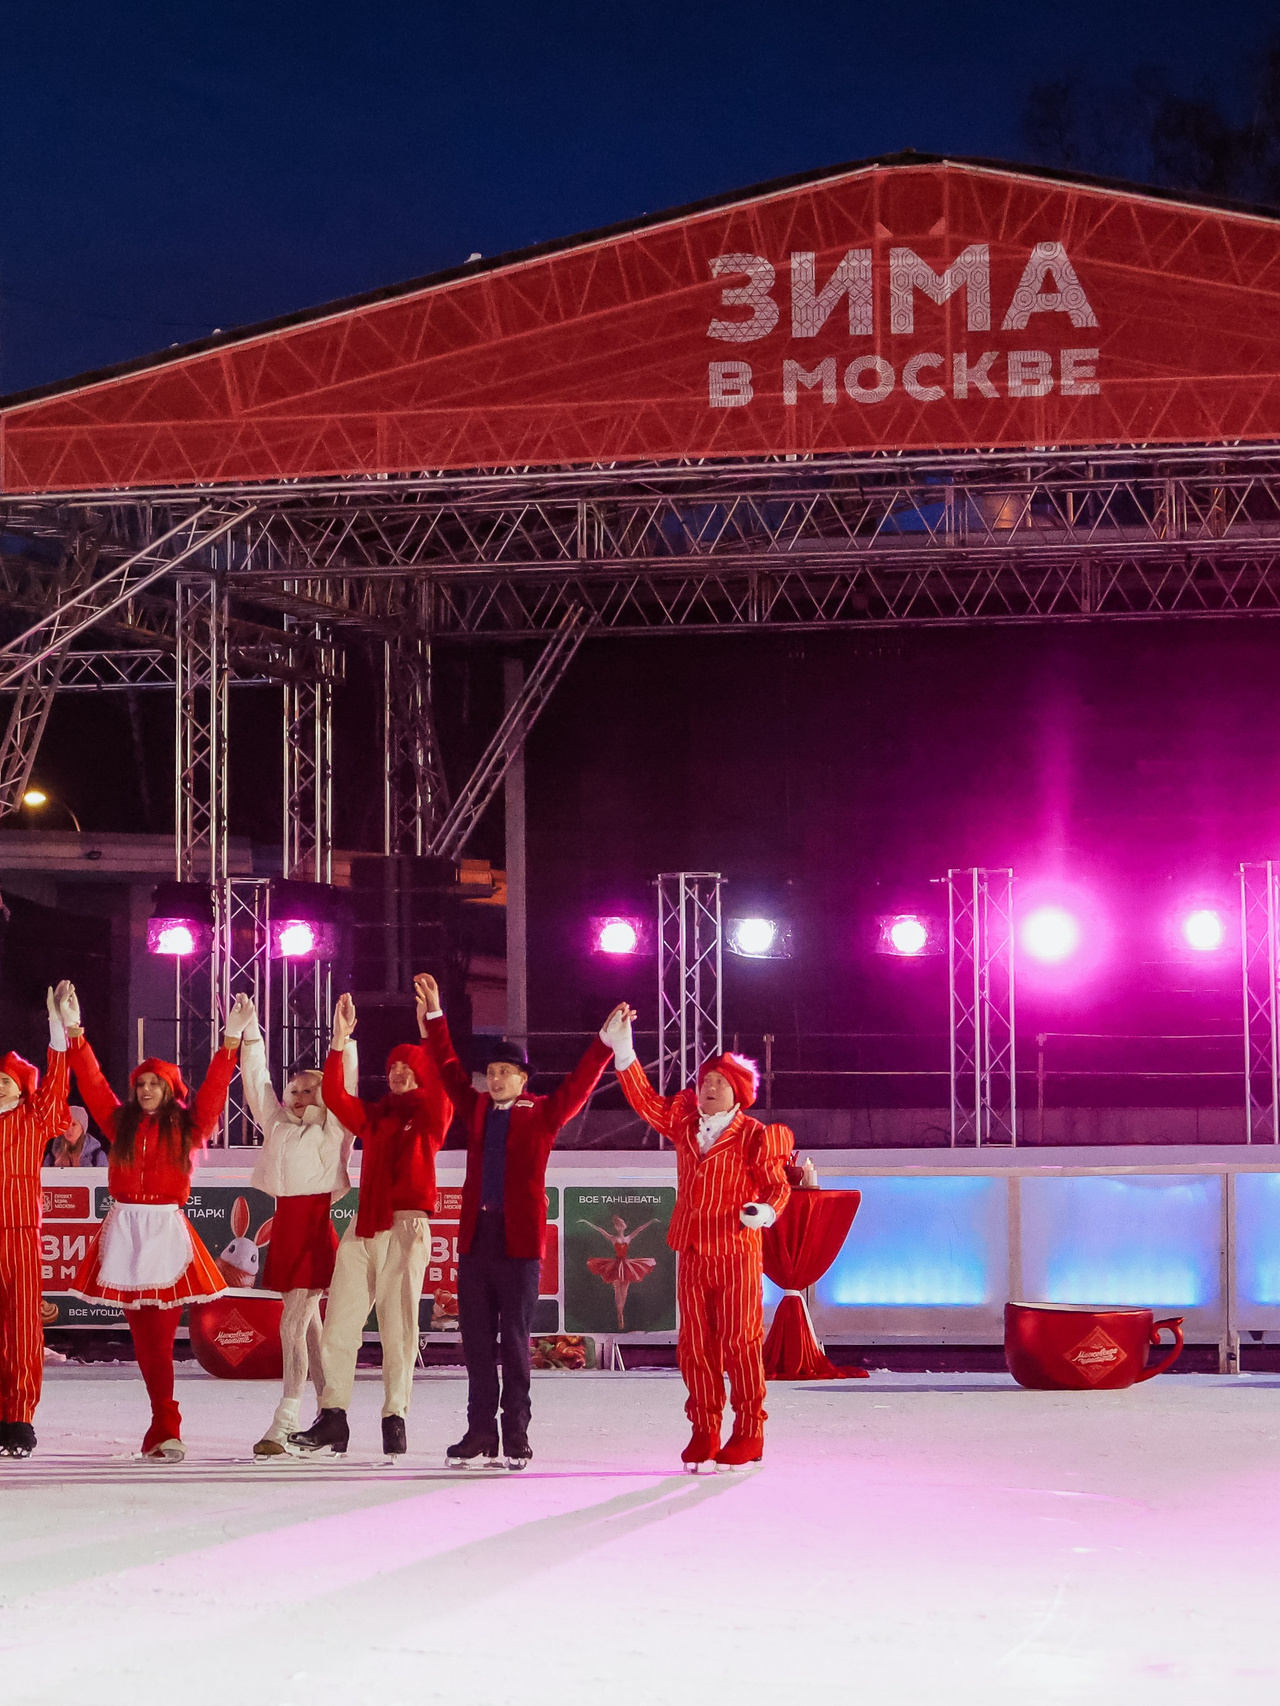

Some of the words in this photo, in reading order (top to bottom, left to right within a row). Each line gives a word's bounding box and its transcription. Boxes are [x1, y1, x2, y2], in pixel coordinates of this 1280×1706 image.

[706, 241, 1100, 343] ЗИМА
[708, 360, 754, 408] В
[782, 348, 1101, 405] МОСКВЕ
[185, 1195, 202, 1206] СЕ
[578, 1195, 599, 1204] ВСЕ
[600, 1195, 662, 1204] ТАНЦЕВАТЬ!
[187, 1208, 225, 1219] ПАРК!
[429, 1267, 442, 1281] В
[68, 1308, 88, 1317] ВСЕ
[89, 1308, 125, 1318] УГОЩА
